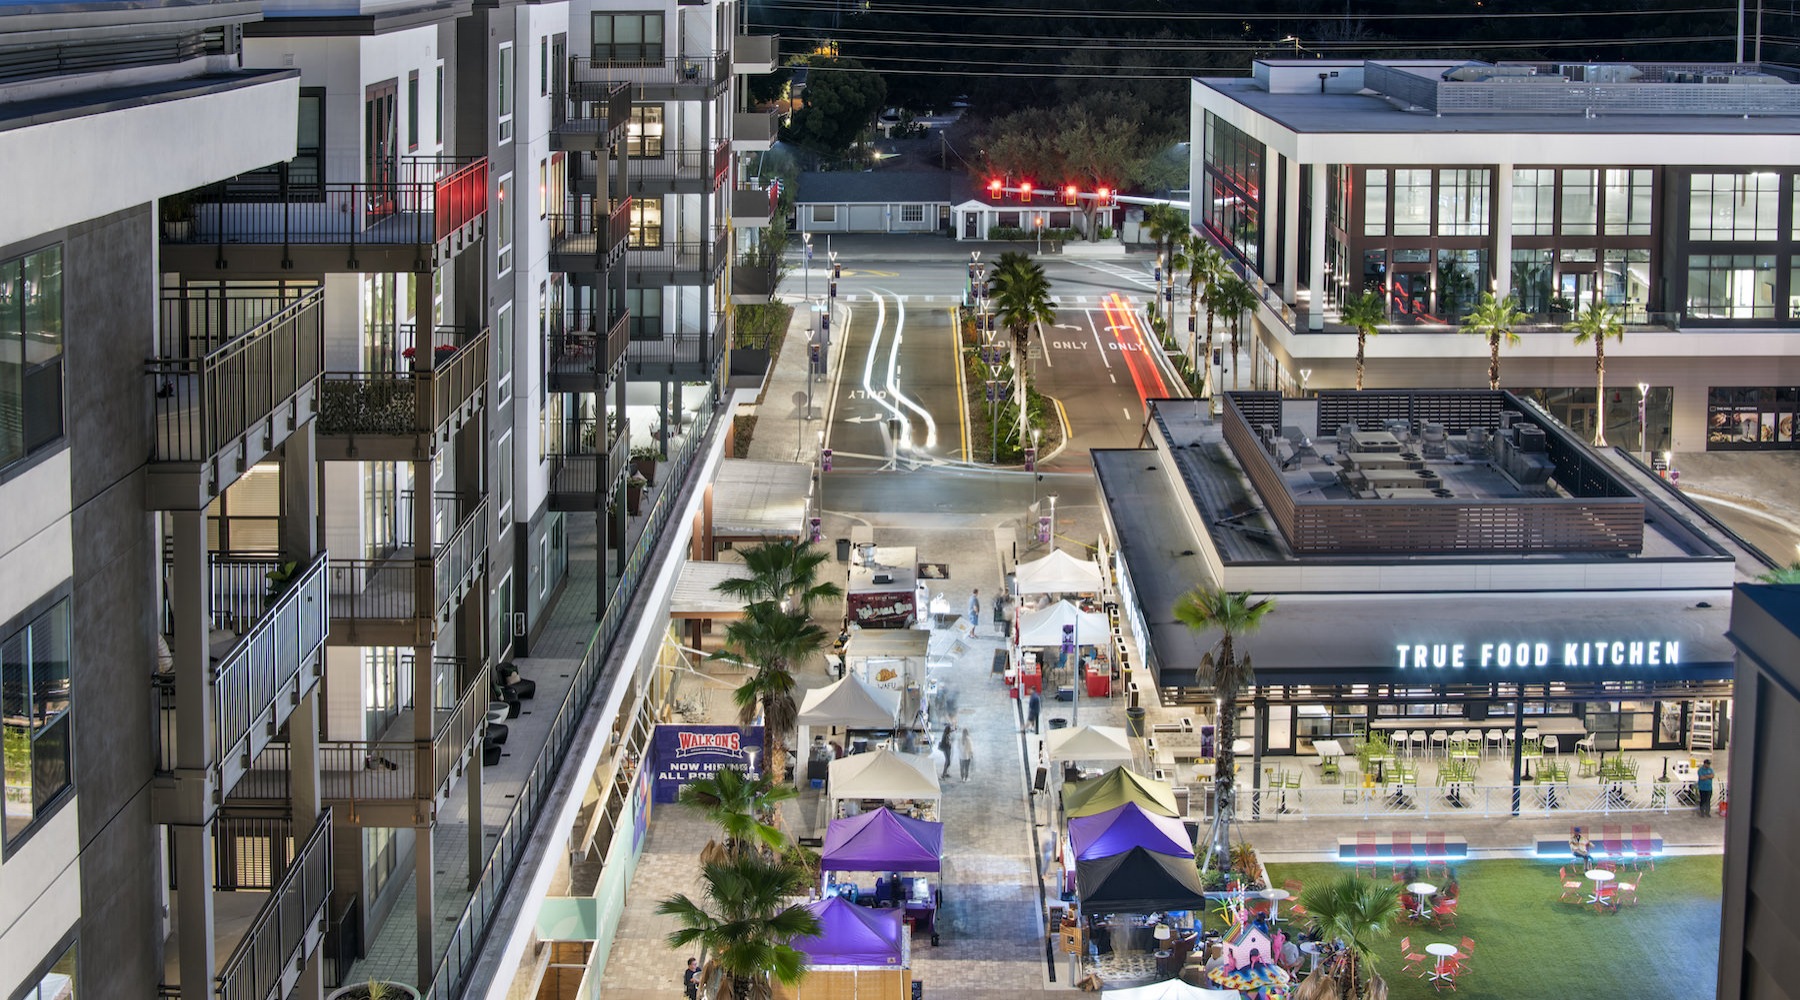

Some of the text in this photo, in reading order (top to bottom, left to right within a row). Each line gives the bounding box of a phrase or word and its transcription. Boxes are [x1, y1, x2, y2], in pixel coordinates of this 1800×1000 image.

[1053, 341, 1088, 350] ONLY
[1108, 342, 1143, 351] ONLY
[848, 390, 887, 399] ONLY
[1396, 640, 1680, 669] TRUE FOOD KITCHEN
[877, 682, 897, 690] WAFU
[670, 763, 700, 771] NOW
[658, 772, 761, 781] ALL POSNS
